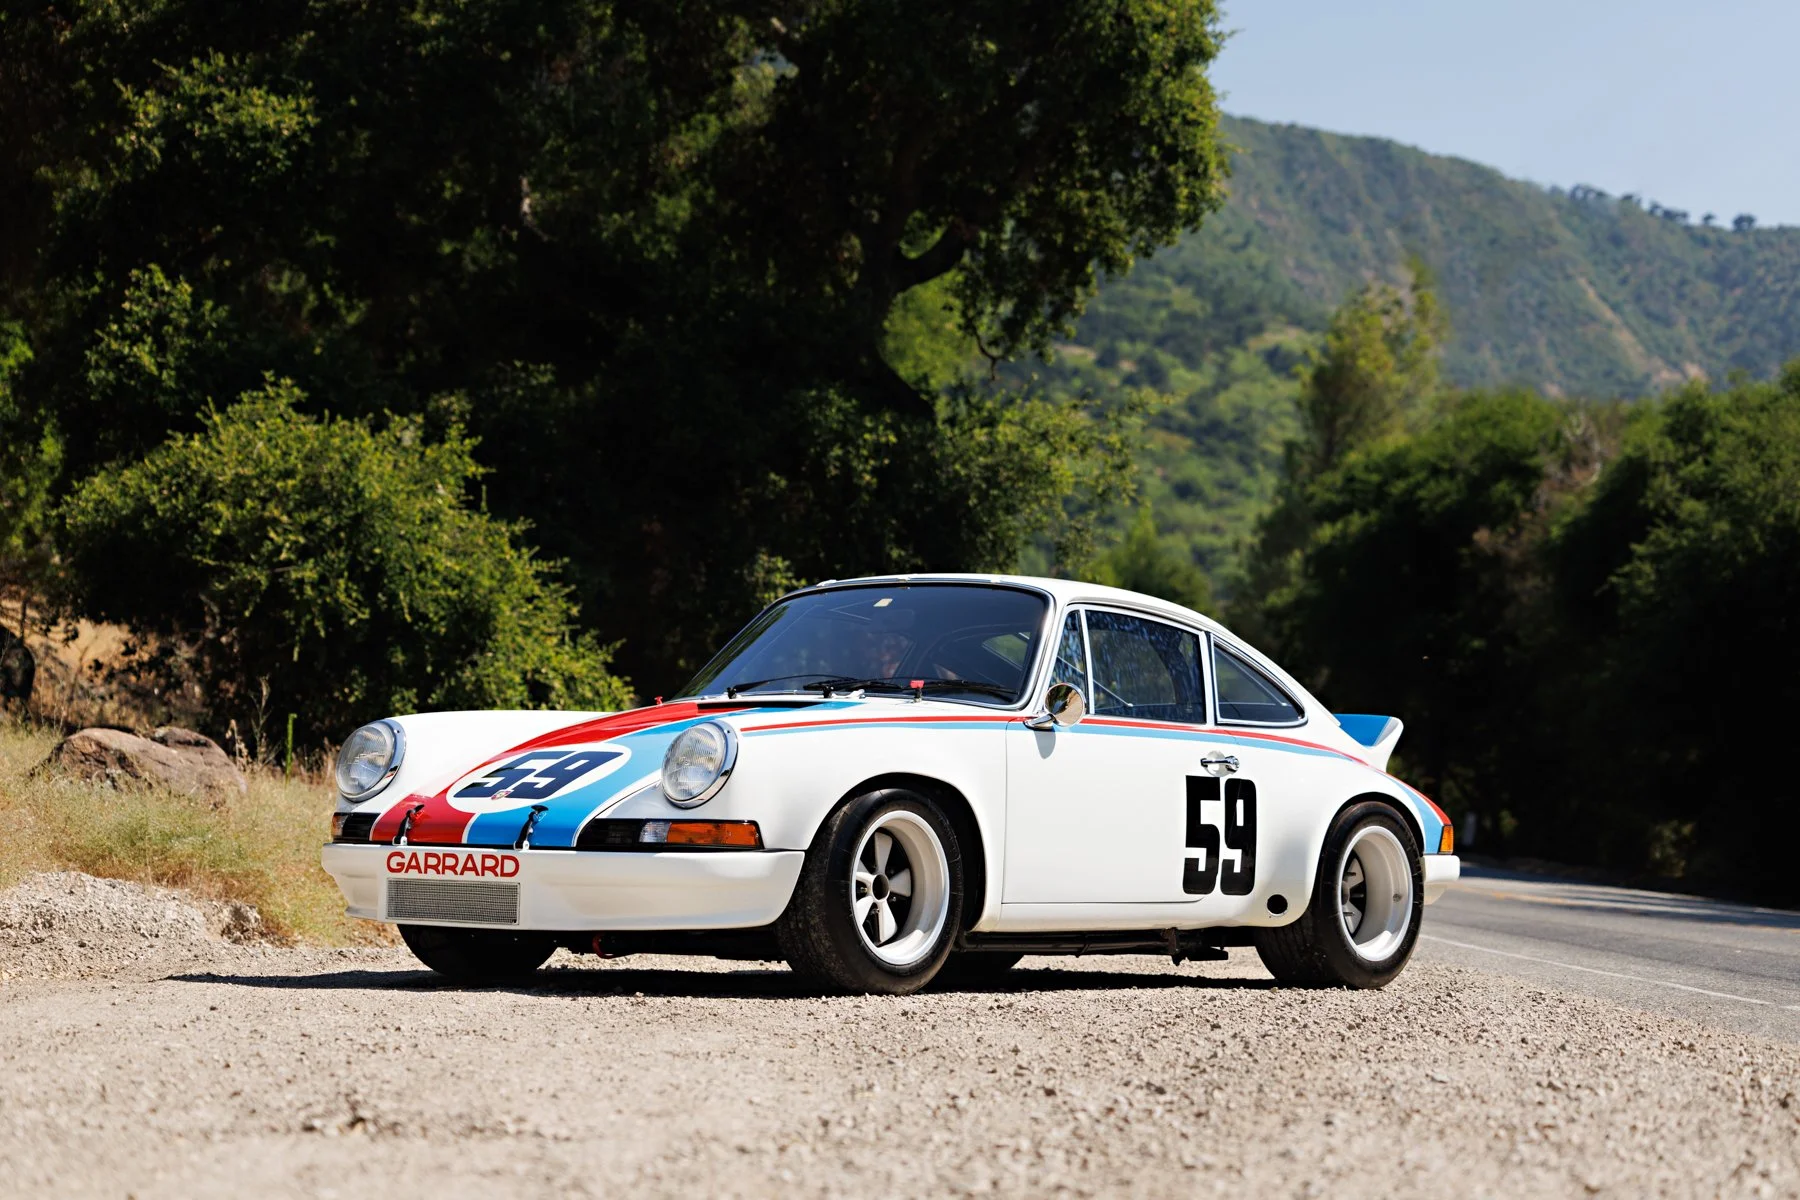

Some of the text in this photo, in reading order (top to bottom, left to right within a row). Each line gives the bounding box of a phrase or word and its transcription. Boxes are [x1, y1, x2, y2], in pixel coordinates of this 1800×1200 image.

[453, 751, 624, 800] 59
[1182, 775, 1257, 896] 59
[386, 851, 520, 878] GARRARD
